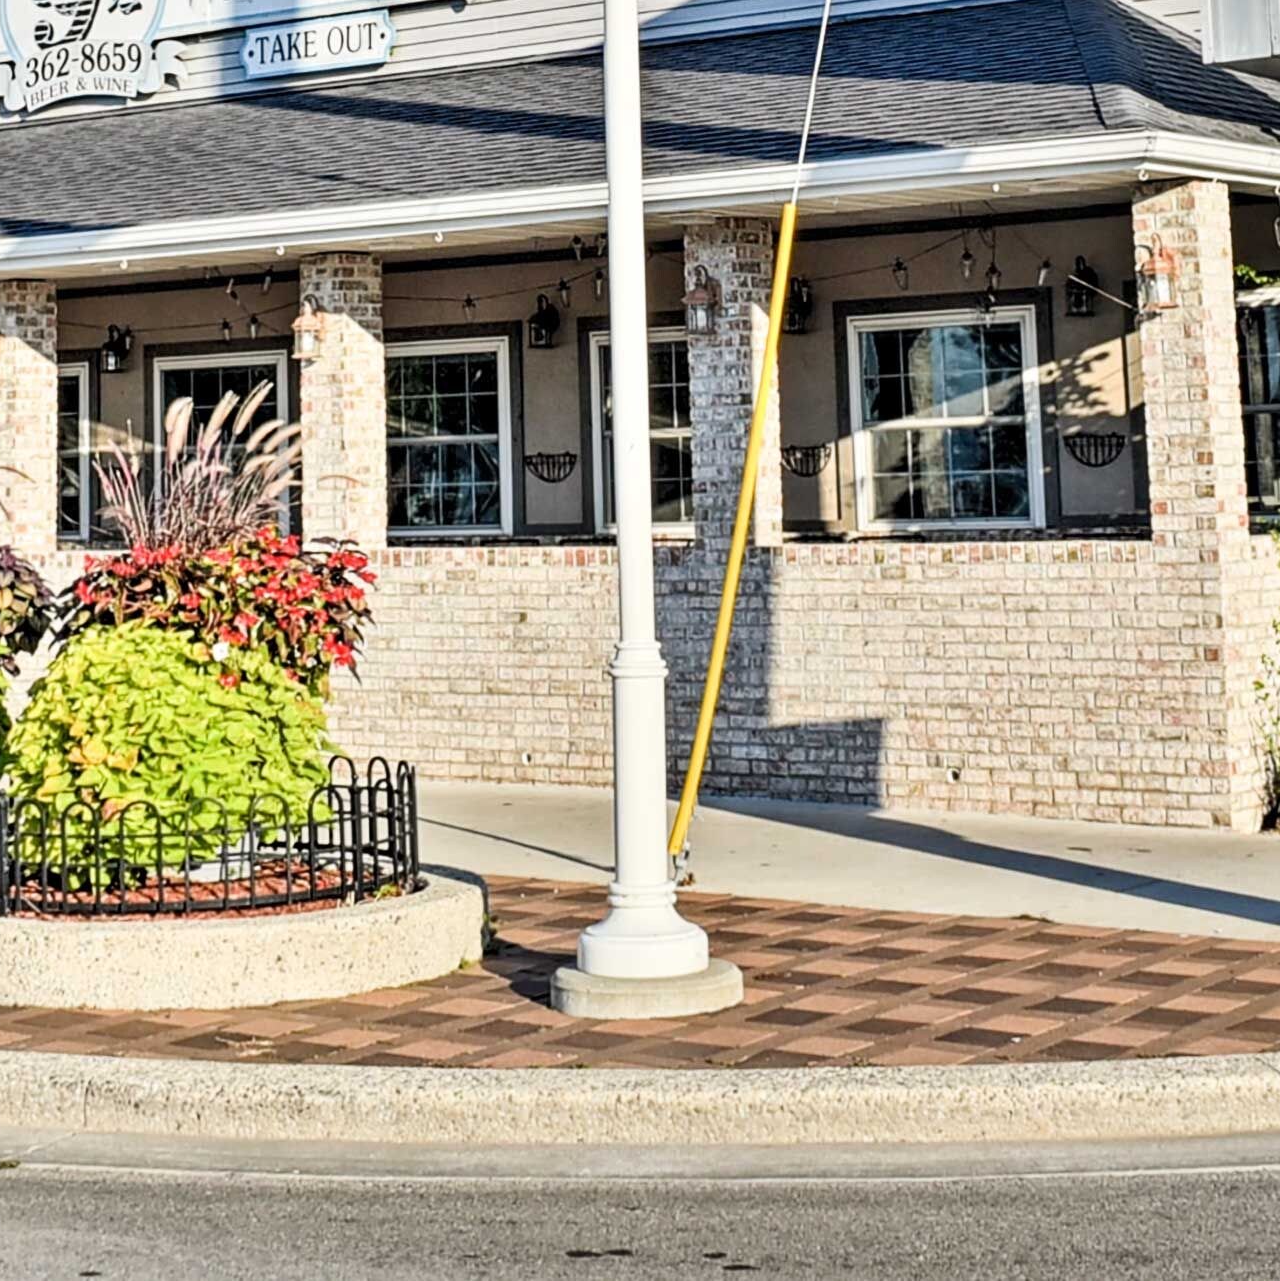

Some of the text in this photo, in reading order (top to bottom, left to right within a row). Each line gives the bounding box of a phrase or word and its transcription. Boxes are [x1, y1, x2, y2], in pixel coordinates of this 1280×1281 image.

[25, 42, 142, 88] 362-8659
[255, 22, 378, 65] TAKE OUT
[30, 76, 135, 107] BEER & WINE
